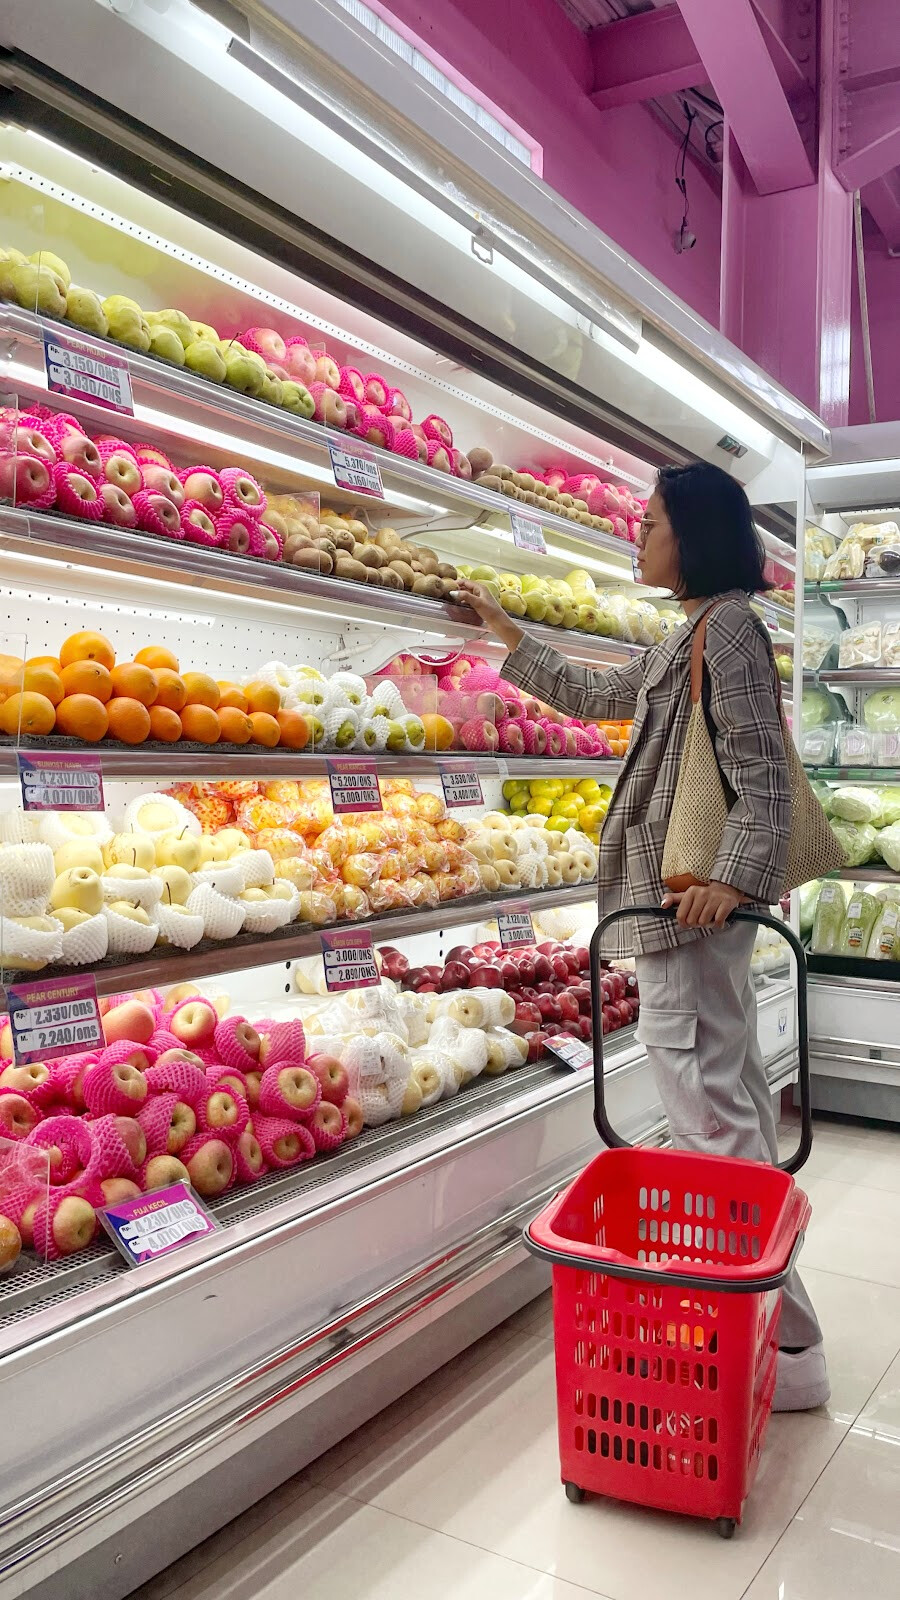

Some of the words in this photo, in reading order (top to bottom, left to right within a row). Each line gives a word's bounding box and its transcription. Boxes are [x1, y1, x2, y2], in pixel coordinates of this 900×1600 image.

[26, 991, 46, 1003] PEAR
[47, 986, 79, 1000] CENTURY
[132, 1206, 148, 1217] FUJI
[147, 1199, 168, 1211] KECIL
[135, 1202, 195, 1233] 4.230/ONS
[148, 1217, 205, 1250] 4.070/ONS
